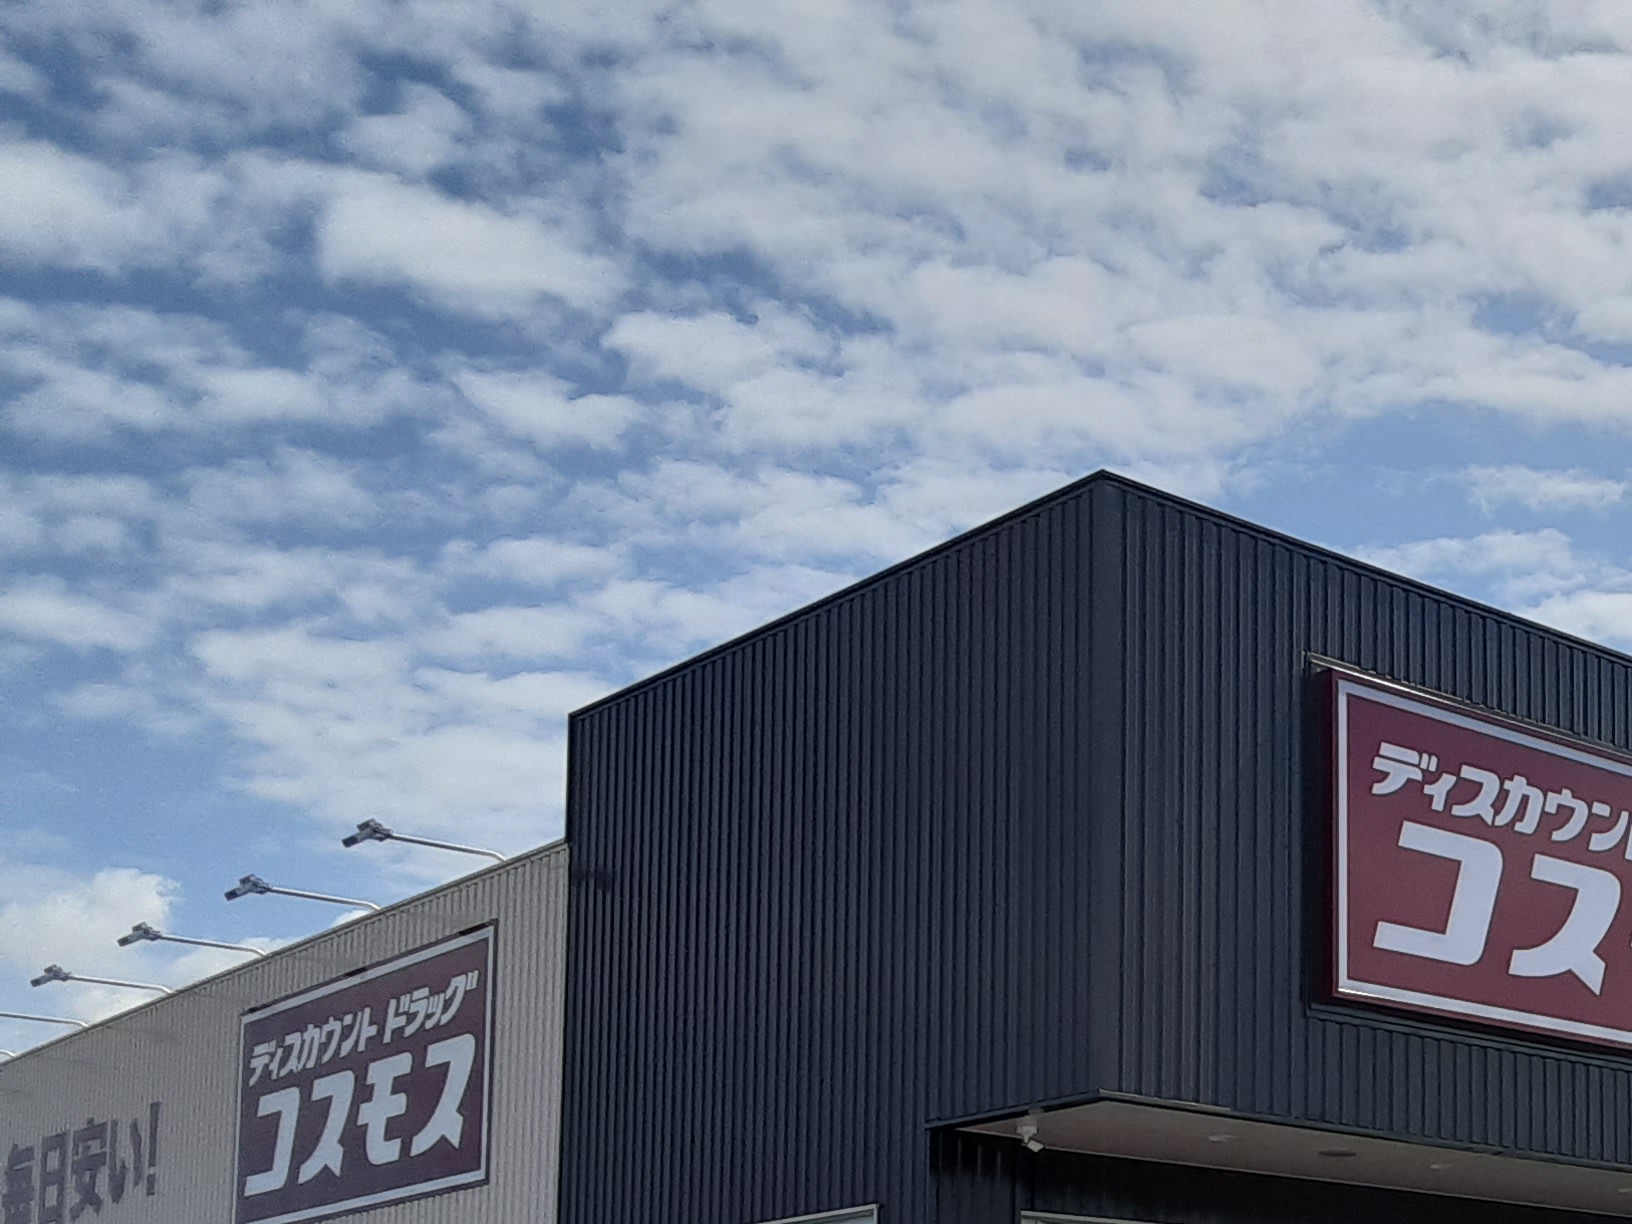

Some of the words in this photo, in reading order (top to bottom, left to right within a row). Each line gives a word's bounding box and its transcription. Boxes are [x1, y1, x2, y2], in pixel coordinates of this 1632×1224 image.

[249, 1006, 379, 1088] ディスカウント
[382, 969, 479, 1044] ドラッグ
[243, 1032, 476, 1198] コスモス
